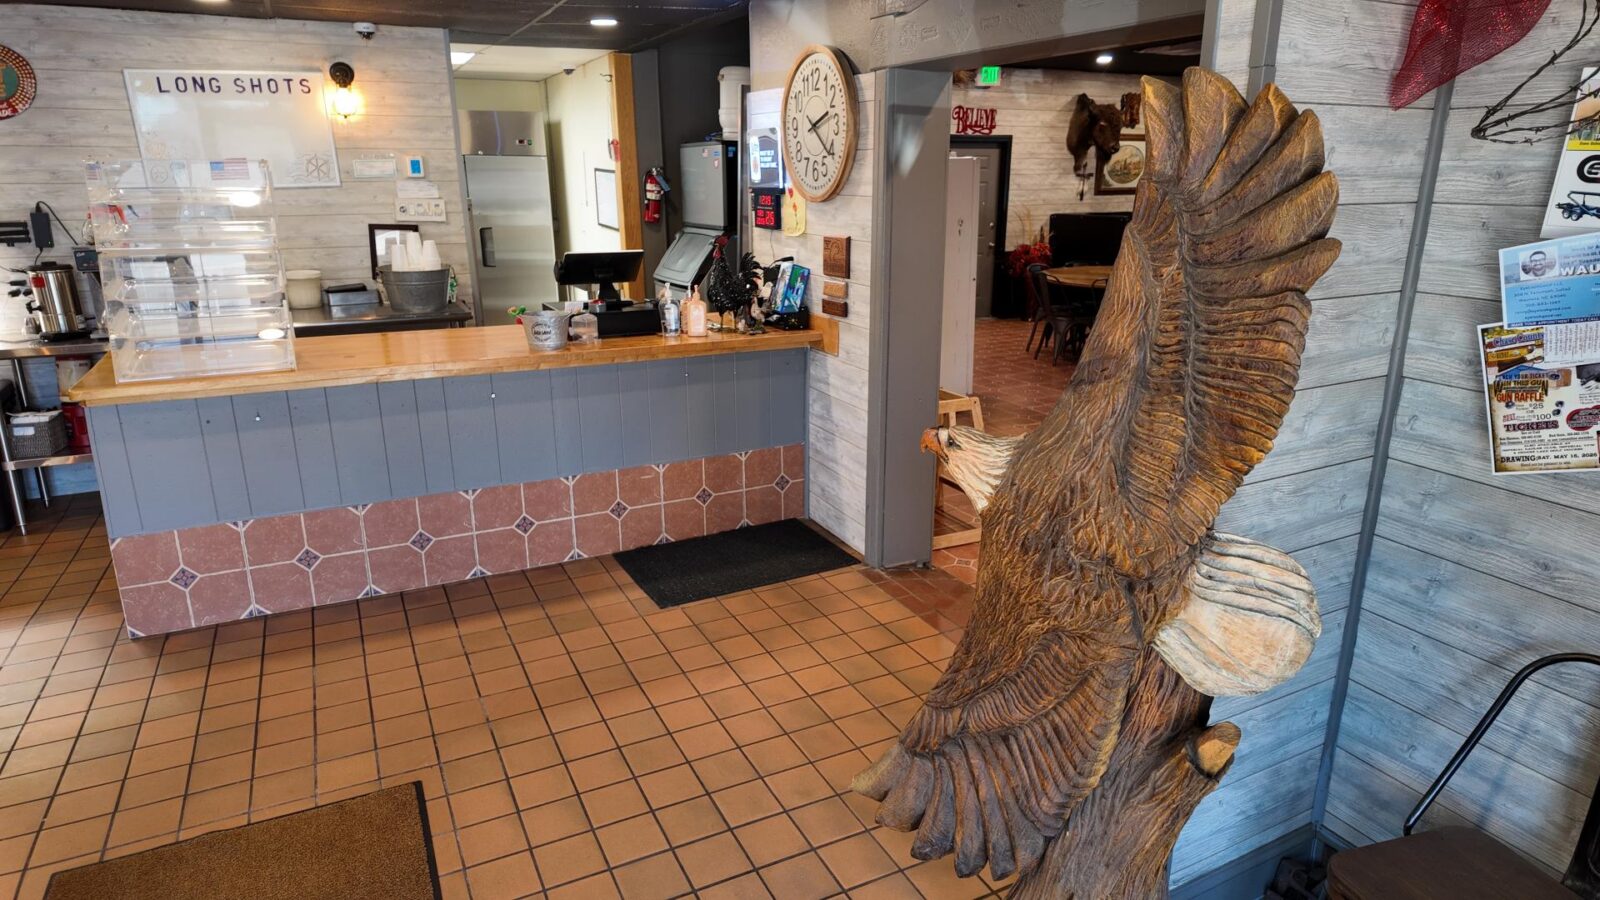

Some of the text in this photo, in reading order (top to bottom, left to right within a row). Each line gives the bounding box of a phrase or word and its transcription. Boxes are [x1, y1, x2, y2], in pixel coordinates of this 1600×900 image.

[156, 76, 312, 94] LONG SHOTS
[803, 74, 810, 97] 11
[811, 67, 821, 91] 12
[824, 72, 828, 97] 1
[982, 67, 998, 83] EXIT
[794, 90, 803, 114] 10
[829, 84, 836, 108] 2
[791, 116, 799, 139] 9
[833, 113, 840, 136] 3
[952, 105, 997, 134] BELIEVE
[795, 140, 803, 163] 8
[828, 138, 835, 160] 4
[803, 157, 810, 177] 7
[812, 160, 819, 182] 6
[821, 155, 828, 177] 5
[1496, 391, 1544, 403] GUN RAFFLE
[1503, 420, 1559, 433] TICKETS
